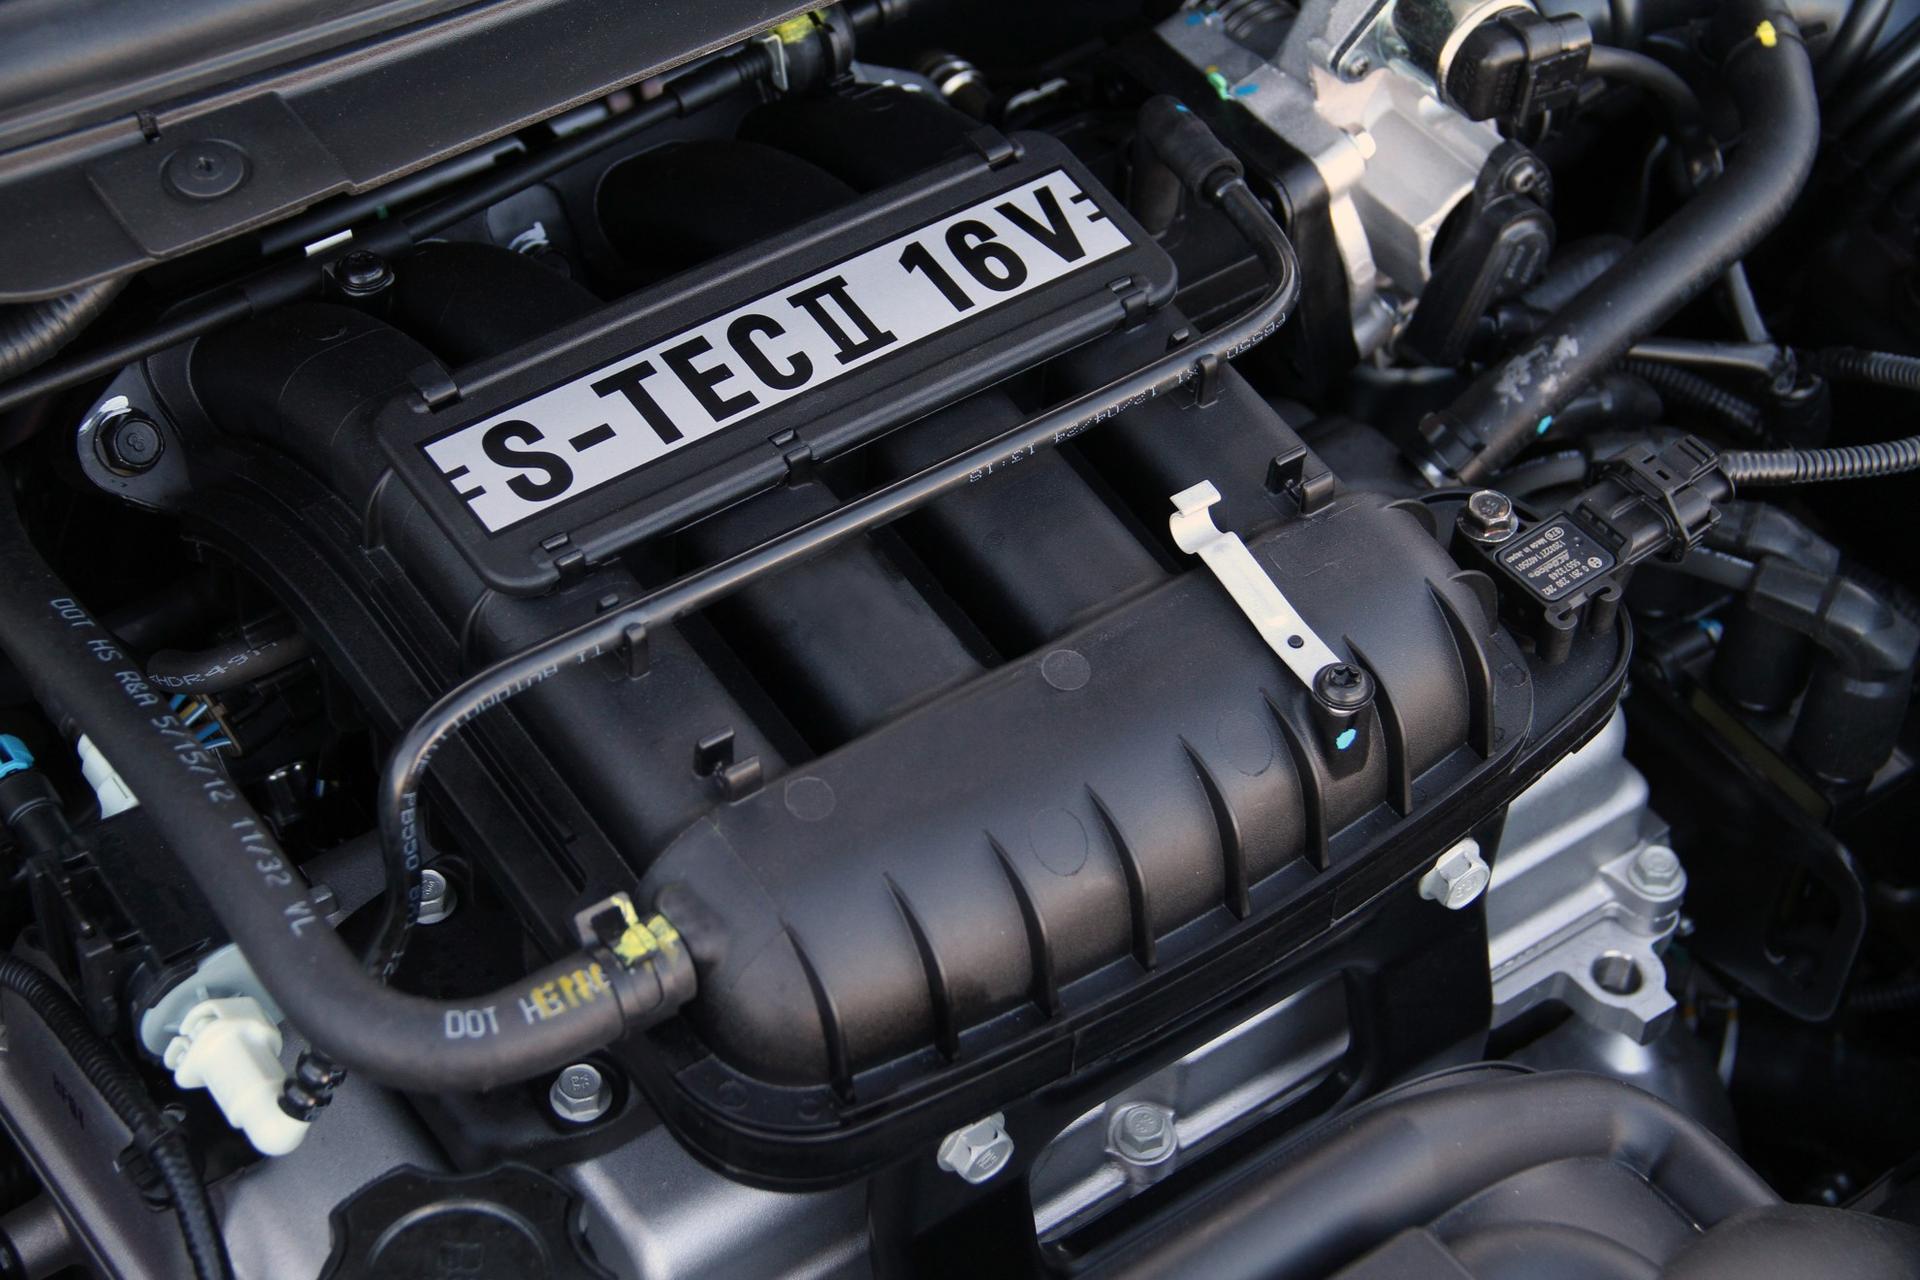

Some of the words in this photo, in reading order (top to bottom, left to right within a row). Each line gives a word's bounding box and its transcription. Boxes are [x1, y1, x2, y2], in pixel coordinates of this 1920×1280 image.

[898, 185, 1088, 313] 16V
[51, 598, 95, 627] DOT
[87, 639, 123, 662] HS
[115, 670, 159, 707] R&A
[151, 714, 237, 803] 5/15/12
[231, 817, 293, 887] 11/32
[445, 1005, 499, 1039] DOT
